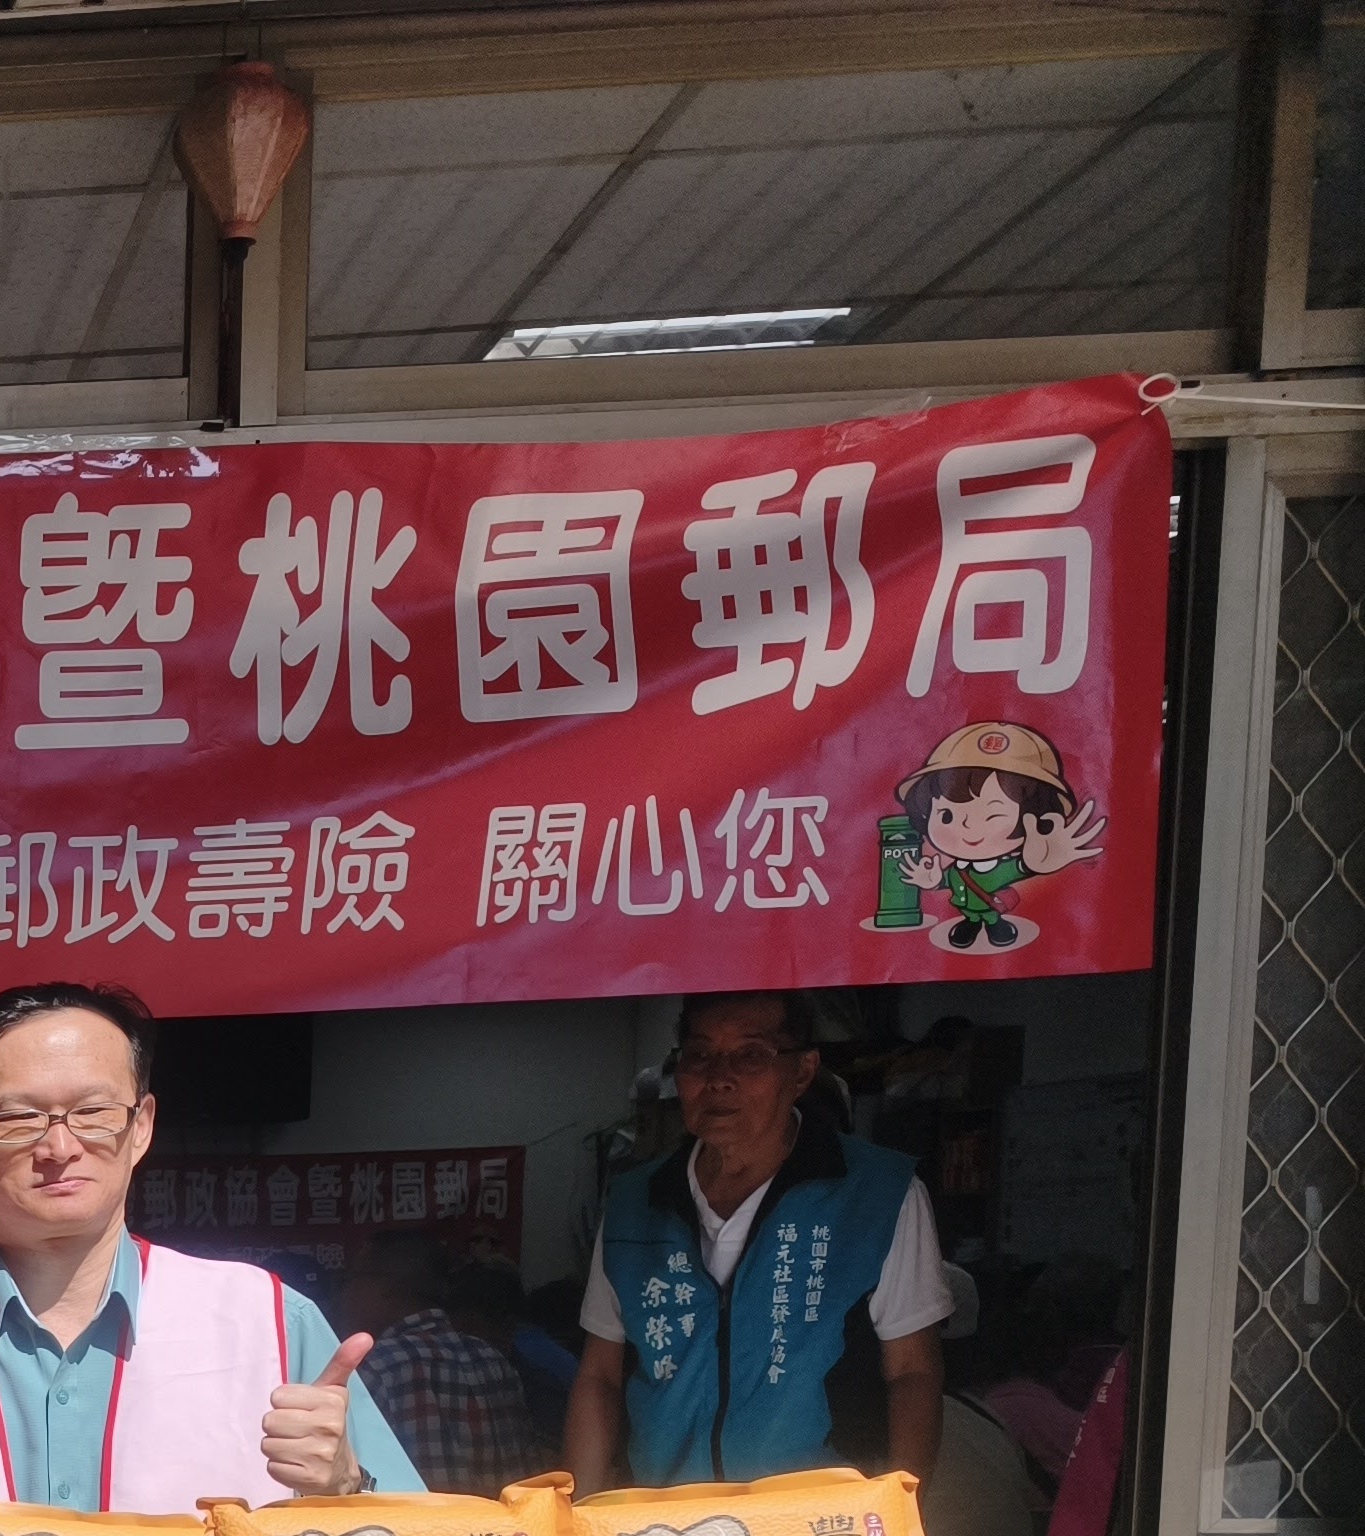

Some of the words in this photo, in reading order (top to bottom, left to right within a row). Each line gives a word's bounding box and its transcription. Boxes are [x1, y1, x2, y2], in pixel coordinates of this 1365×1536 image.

[477, 787, 831, 927] 關心您
[768, 1224, 798, 1384] 福元社區發展協會
[805, 1225, 831, 1323] 桃園市桃園區
